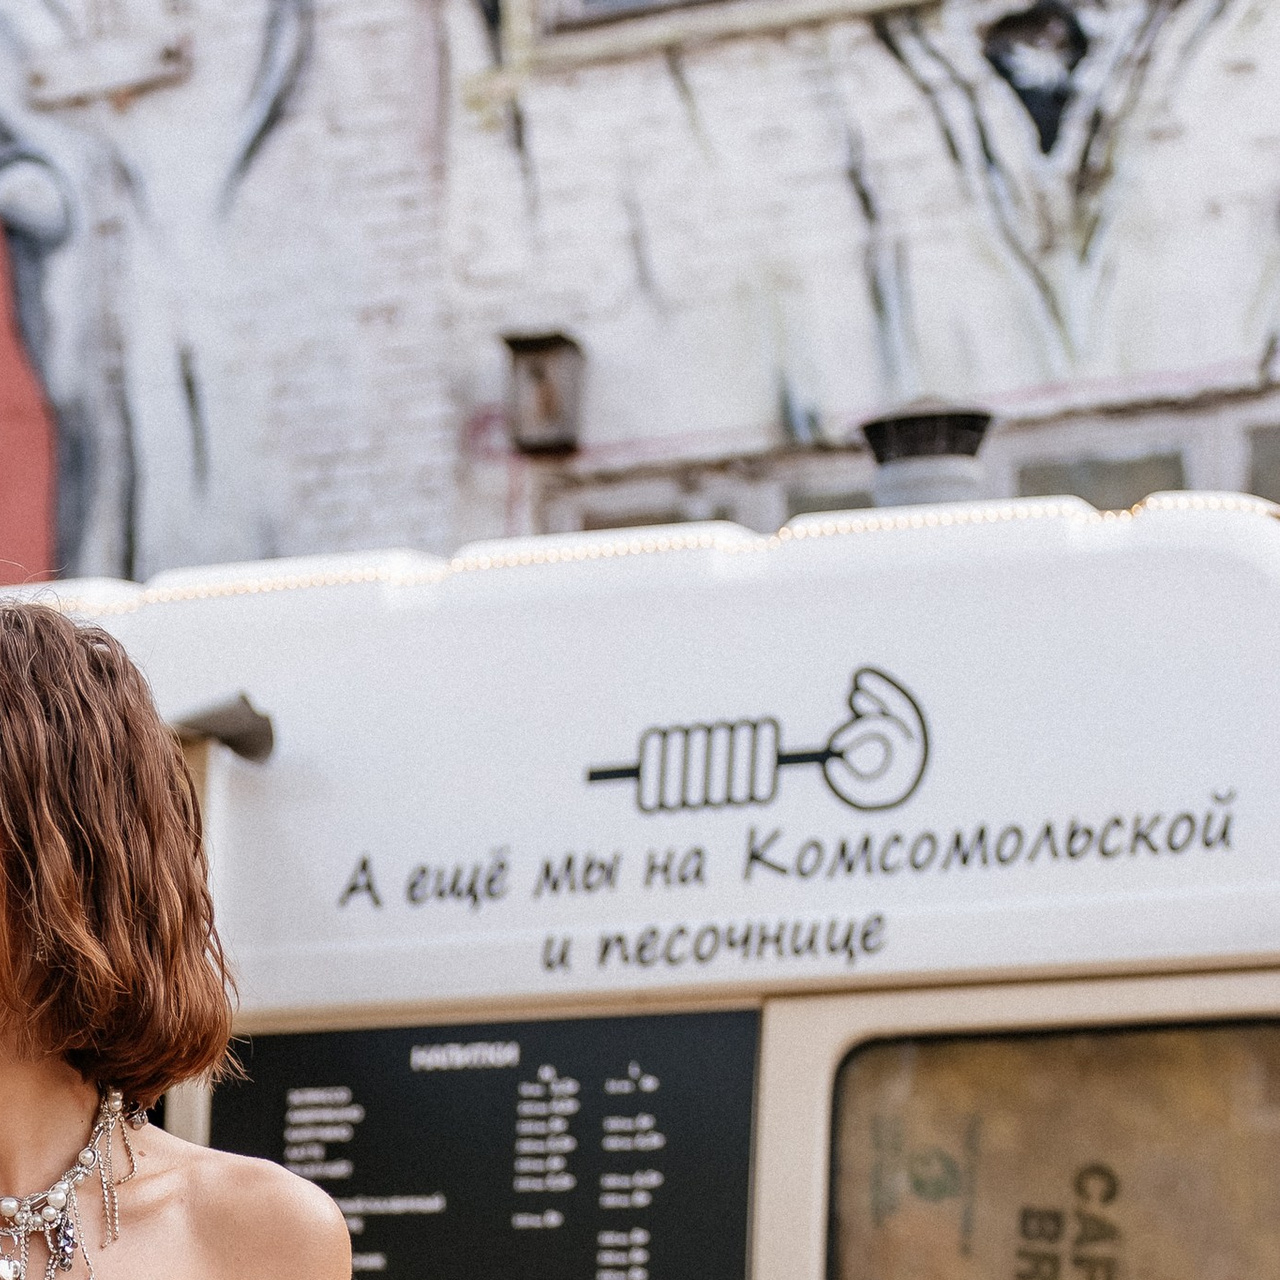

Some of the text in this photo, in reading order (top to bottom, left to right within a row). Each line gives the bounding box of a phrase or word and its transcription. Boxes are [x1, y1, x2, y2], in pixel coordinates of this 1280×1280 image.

[338, 791, 1236, 912] А ещё мы на Комсомольской
[541, 911, 888, 971] и песочнице
